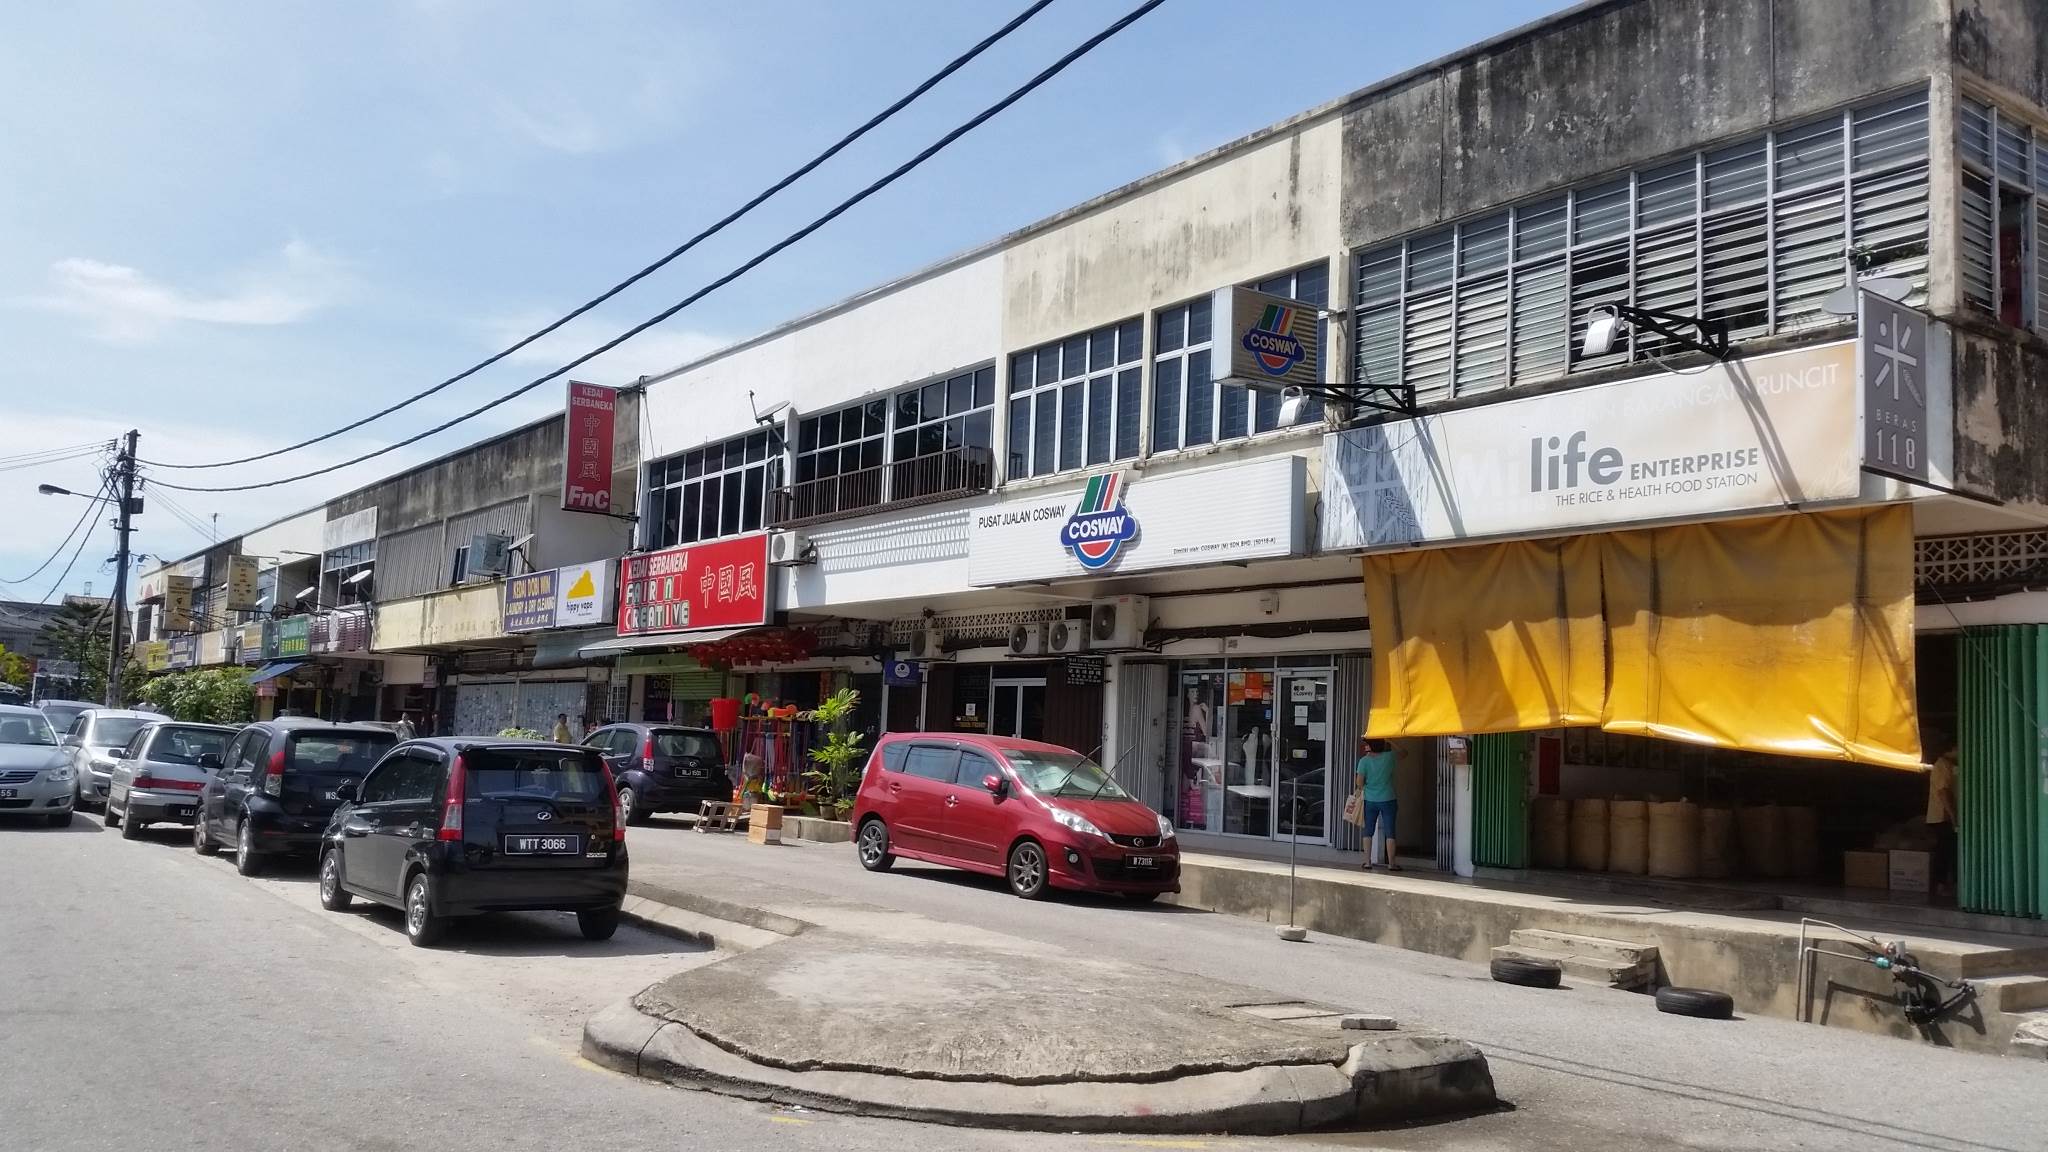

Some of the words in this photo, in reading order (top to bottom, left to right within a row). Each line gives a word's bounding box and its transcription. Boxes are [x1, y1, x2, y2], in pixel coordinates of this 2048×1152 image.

[1250, 333, 1297, 356] COSWAY
[582, 387, 603, 397] KEDAI
[1756, 363, 1839, 397] RUNCIT
[572, 396, 613, 411] SERBANEKA
[1876, 408, 1917, 433] BERAS
[579, 413, 600, 482] 中國風
[1876, 429, 1916, 470] 118
[1531, 430, 1623, 493] life
[1630, 448, 1758, 481] ENTERPRISE
[567, 485, 610, 509] FnC
[1556, 493, 1575, 506] THE
[1579, 490, 1603, 504] RICE
[1606, 489, 1615, 501] &
[1620, 483, 1661, 500] HEALTH
[1665, 479, 1702, 495] FOOD
[1706, 472, 1758, 489] STATION
[979, 514, 1001, 528] PUSAT
[1002, 510, 1031, 525] JUALAN
[1033, 504, 1067, 521] COSWAY
[1069, 515, 1125, 539] COSWAY
[628, 557, 648, 579] KEDAI
[649, 552, 689, 576] SERBANEKA
[626, 579, 657, 604] FAIR
[701, 562, 757, 608] 中國風
[625, 602, 689, 630] CREATIVE
[519, 838, 539, 850] WTT
[541, 838, 566, 850] 3066
